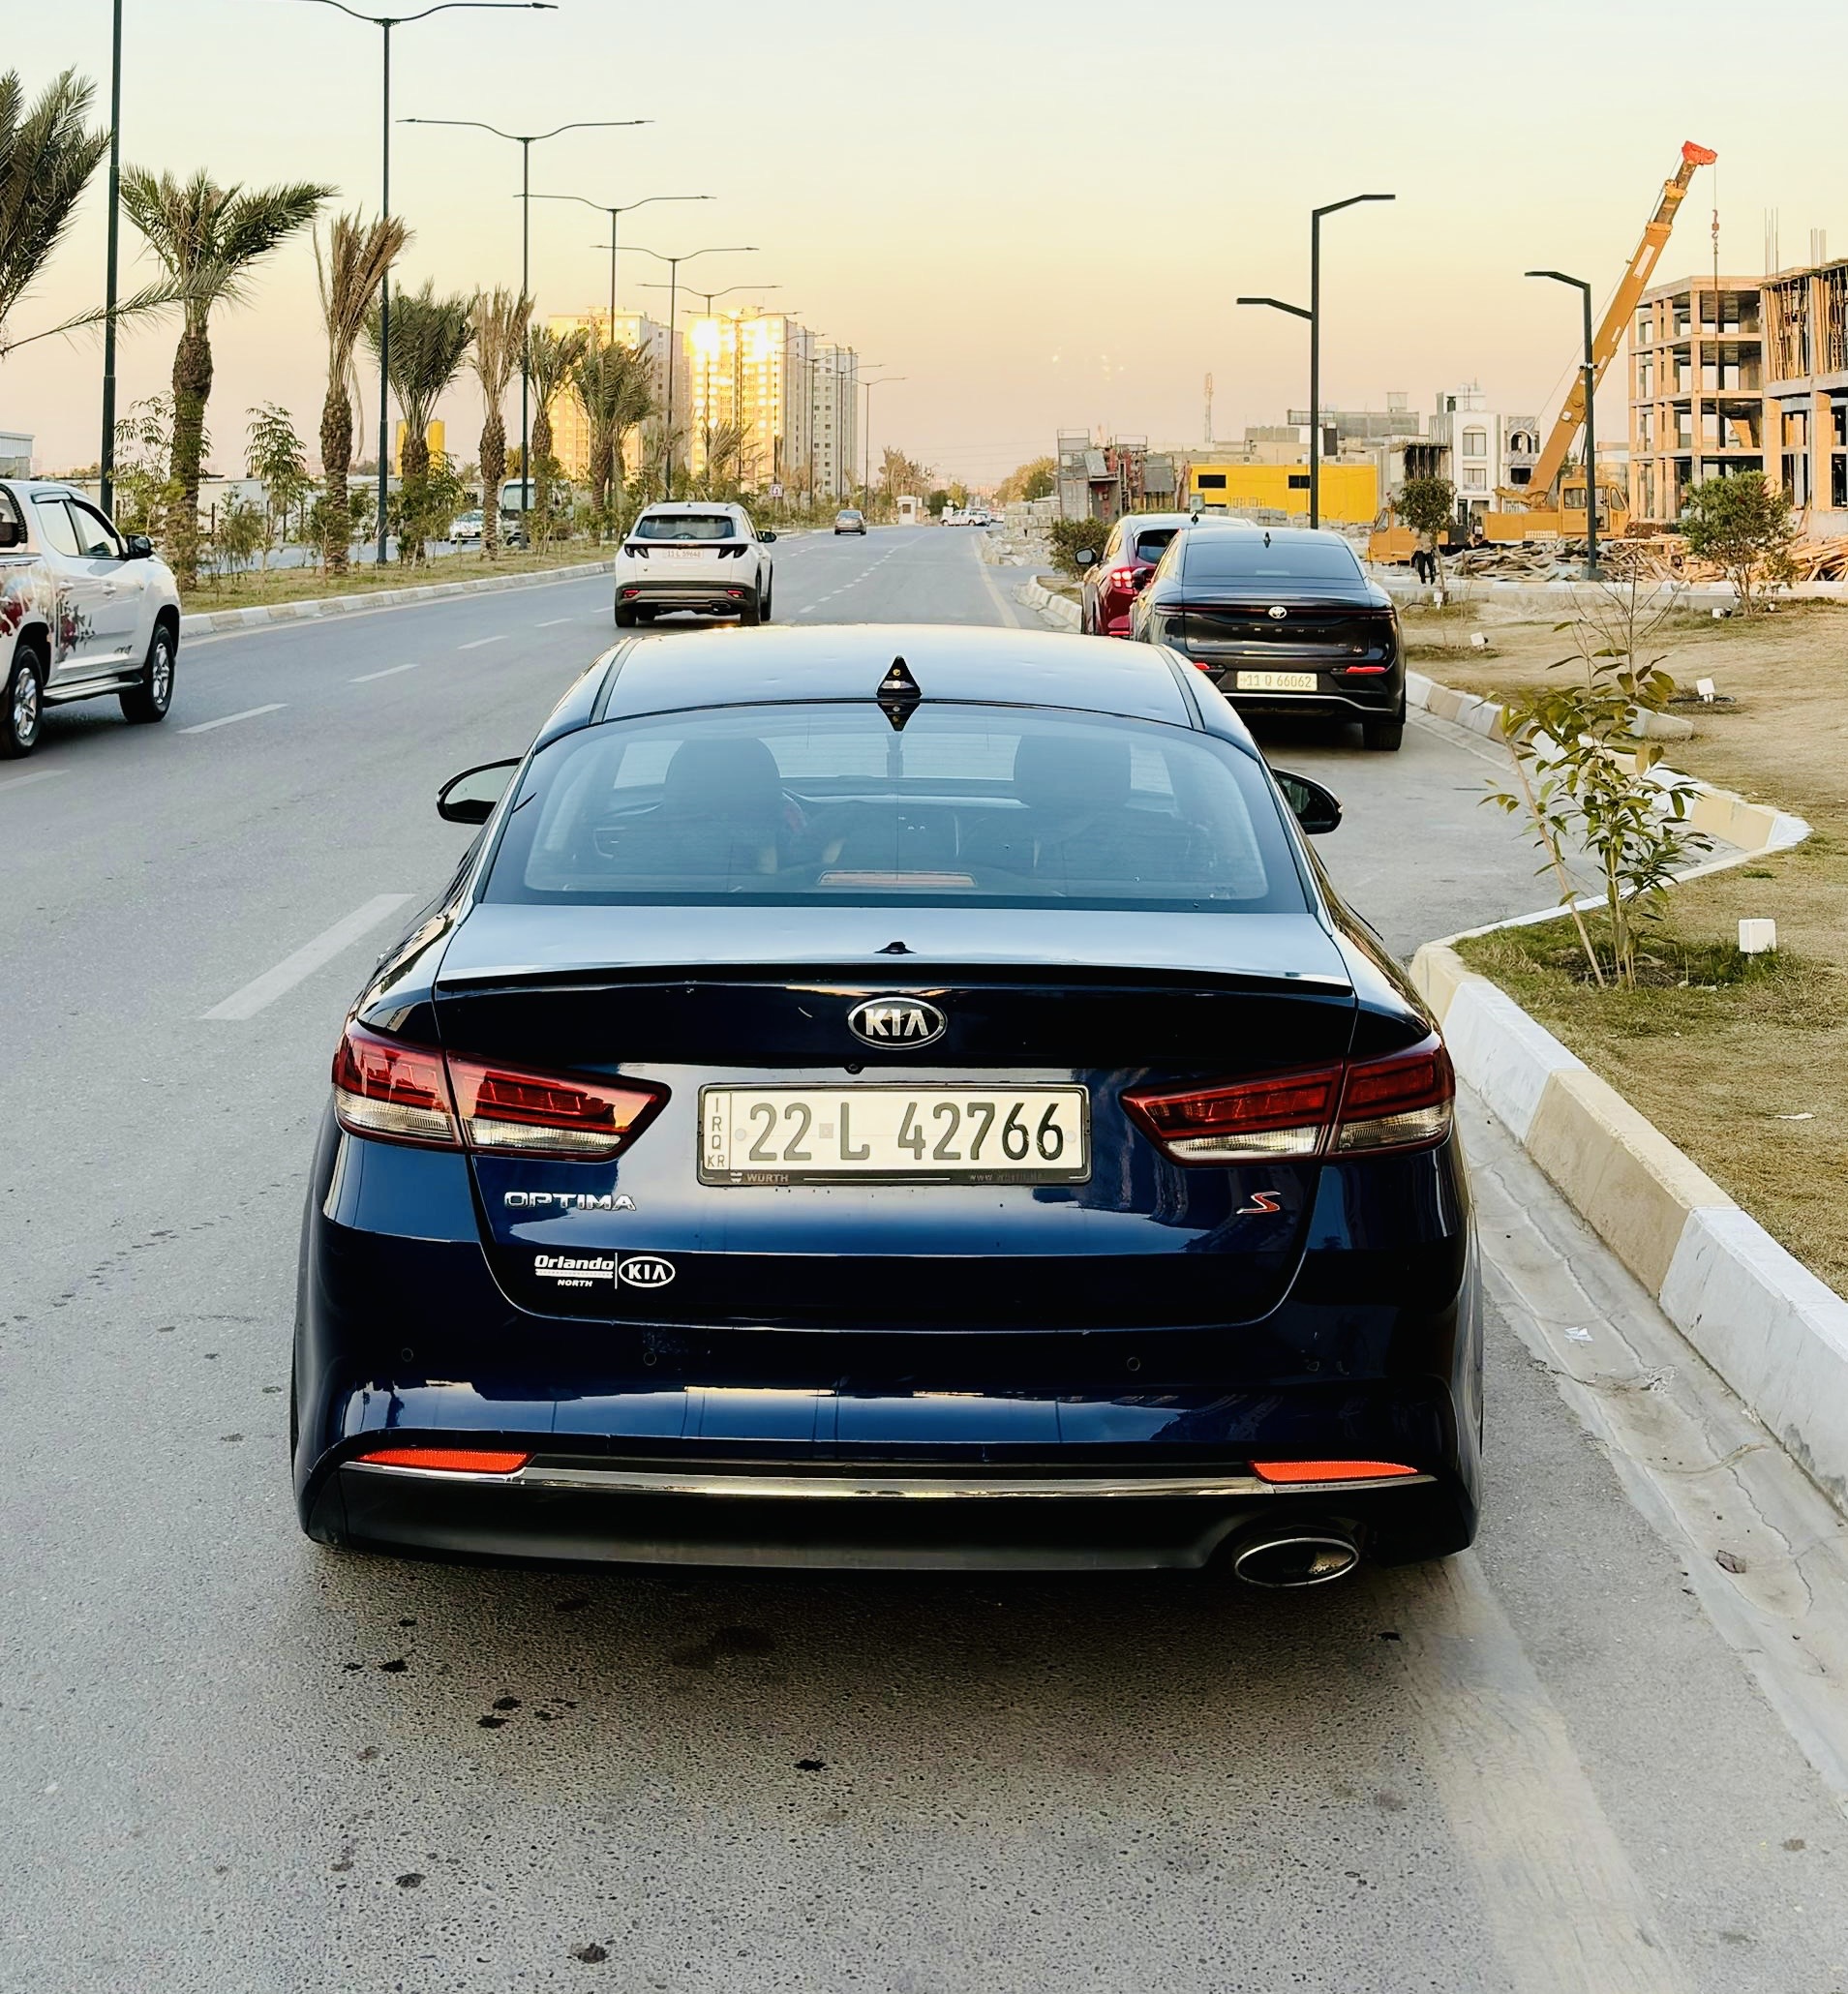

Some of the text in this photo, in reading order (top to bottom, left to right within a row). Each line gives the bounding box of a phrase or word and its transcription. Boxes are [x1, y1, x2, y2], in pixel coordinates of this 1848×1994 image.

[1246, 674, 1260, 686] 11
[1276, 675, 1312, 688] 66062
[863, 1008, 929, 1037] KIA
[748, 1102, 1065, 1162] 22 L 42766
[707, 1154, 725, 1168] KR
[503, 1191, 637, 1211] OPTIMA
[1235, 1191, 1282, 1215] S
[533, 1254, 615, 1271] Orlando
[628, 1263, 668, 1282] KIA
[557, 1279, 593, 1288] NORTH
